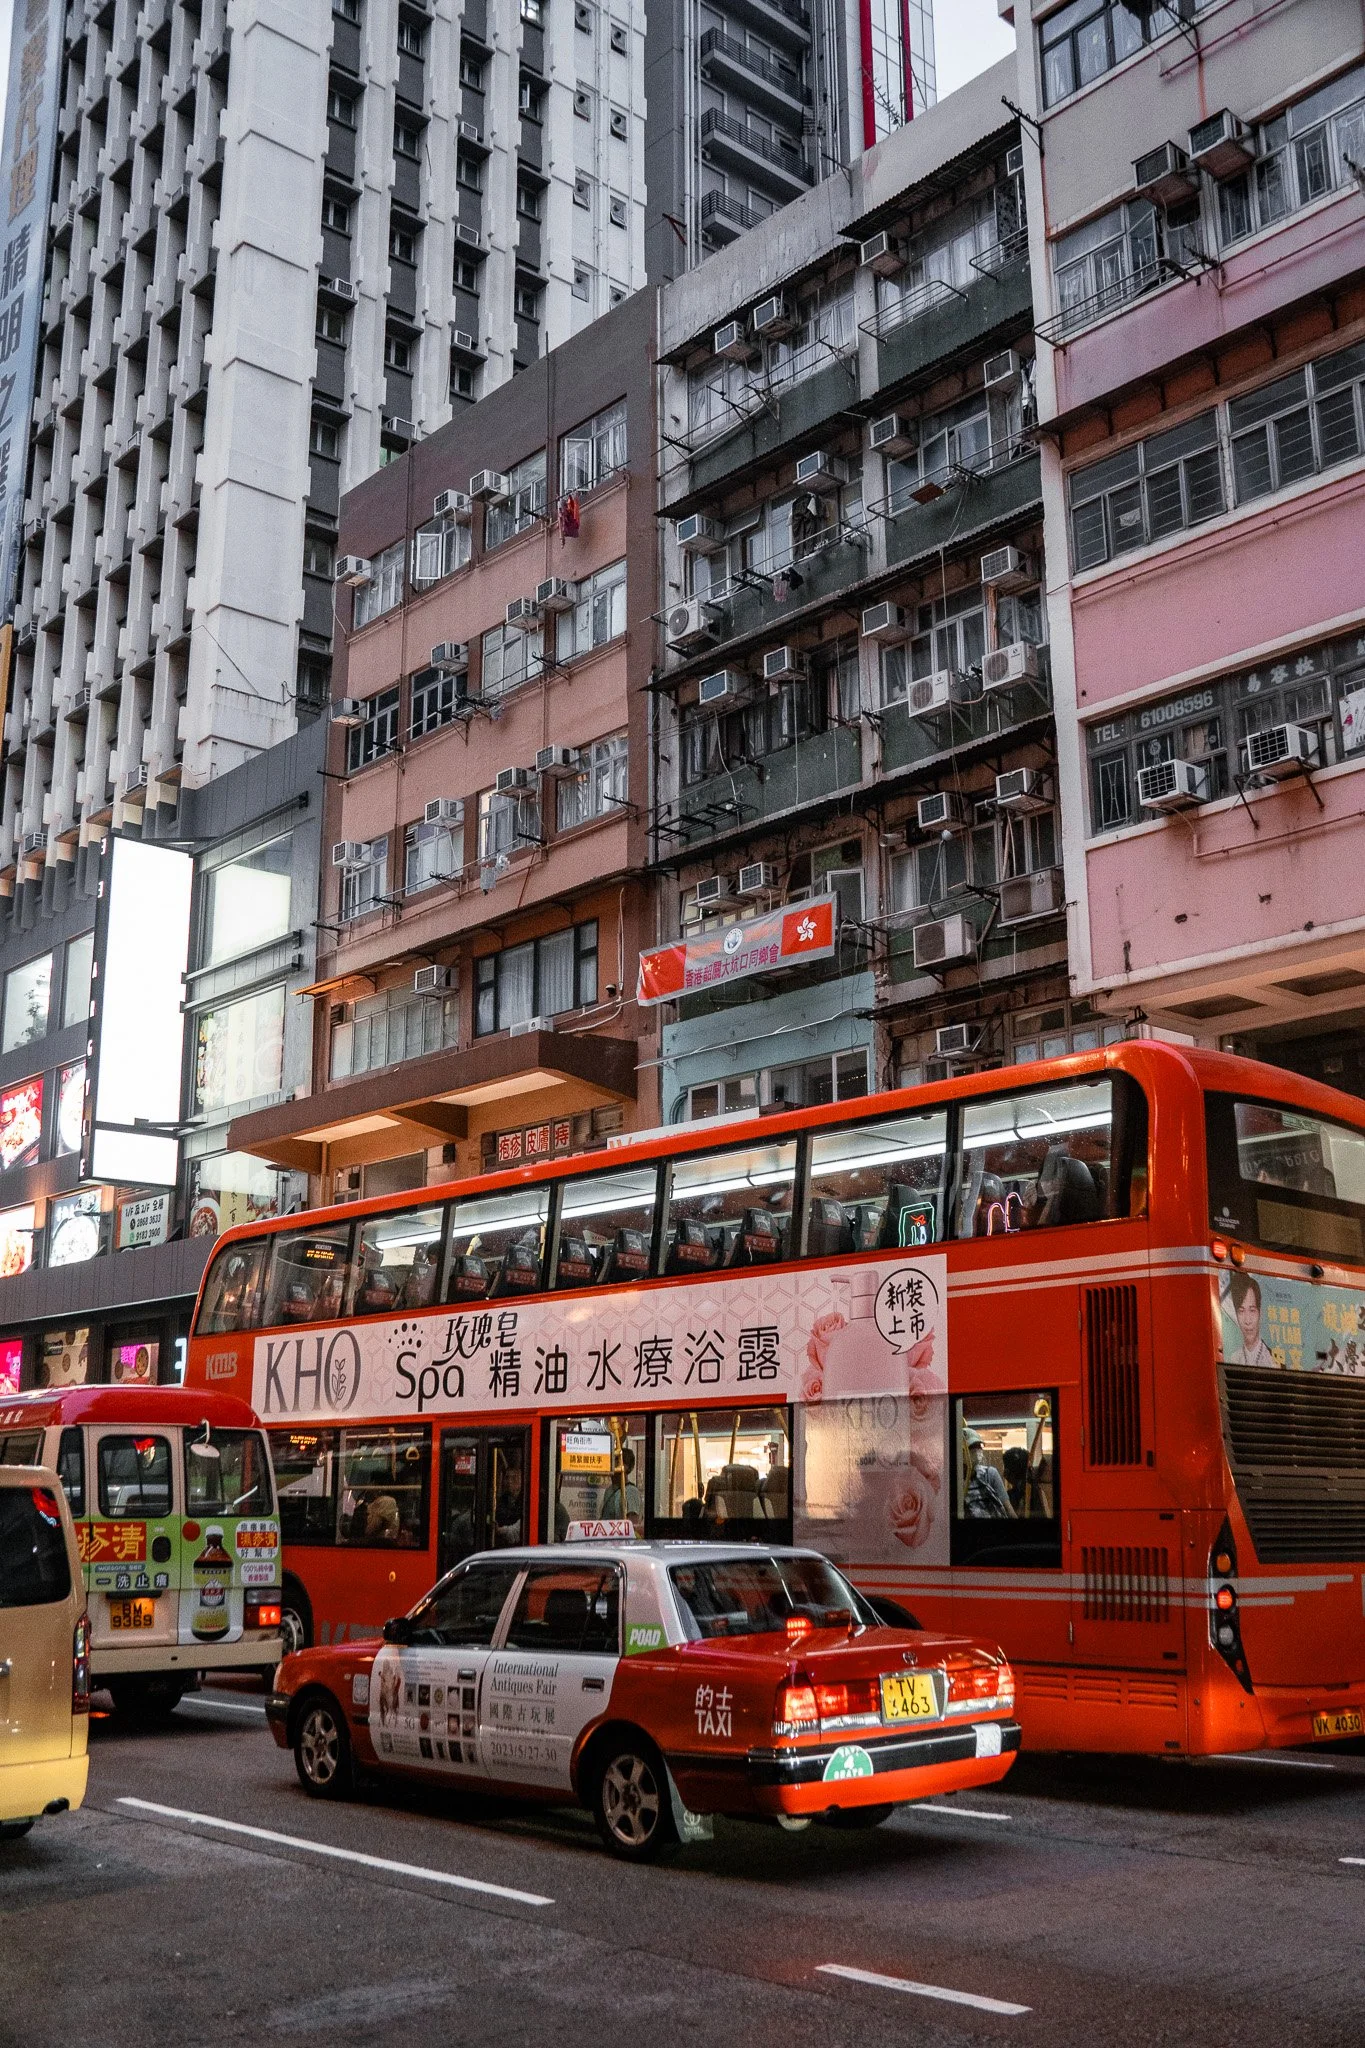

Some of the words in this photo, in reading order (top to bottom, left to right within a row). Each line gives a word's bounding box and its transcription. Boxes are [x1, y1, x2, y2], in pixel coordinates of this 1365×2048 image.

[1140, 691, 1213, 728] 61008596
[685, 943, 780, 988] 香港韶關大坑口同鄉會
[527, 1126, 549, 1154] 皮膚
[555, 1123, 569, 1148] 痔
[885, 1278, 925, 1312] 新裝
[440, 1311, 519, 1367] 玫瑰皂
[888, 1309, 925, 1341] 上市
[205, 1351, 238, 1380] KMB
[263, 1329, 362, 1415] KHO
[395, 1350, 465, 1412] Spa
[488, 1325, 781, 1399] 精油水療浴露
[580, 1521, 630, 1537] TAXI
[112, 1615, 152, 1628] 9369
[629, 1628, 662, 1646] POAD
[493, 1659, 559, 1678] International
[490, 1677, 533, 1695] Antiques
[536, 1679, 557, 1696] Fair
[695, 1684, 732, 1709] 的士
[896, 1679, 915, 1697] TV
[489, 1702, 555, 1724] 國際古玩展
[695, 1709, 732, 1737] TAXI
